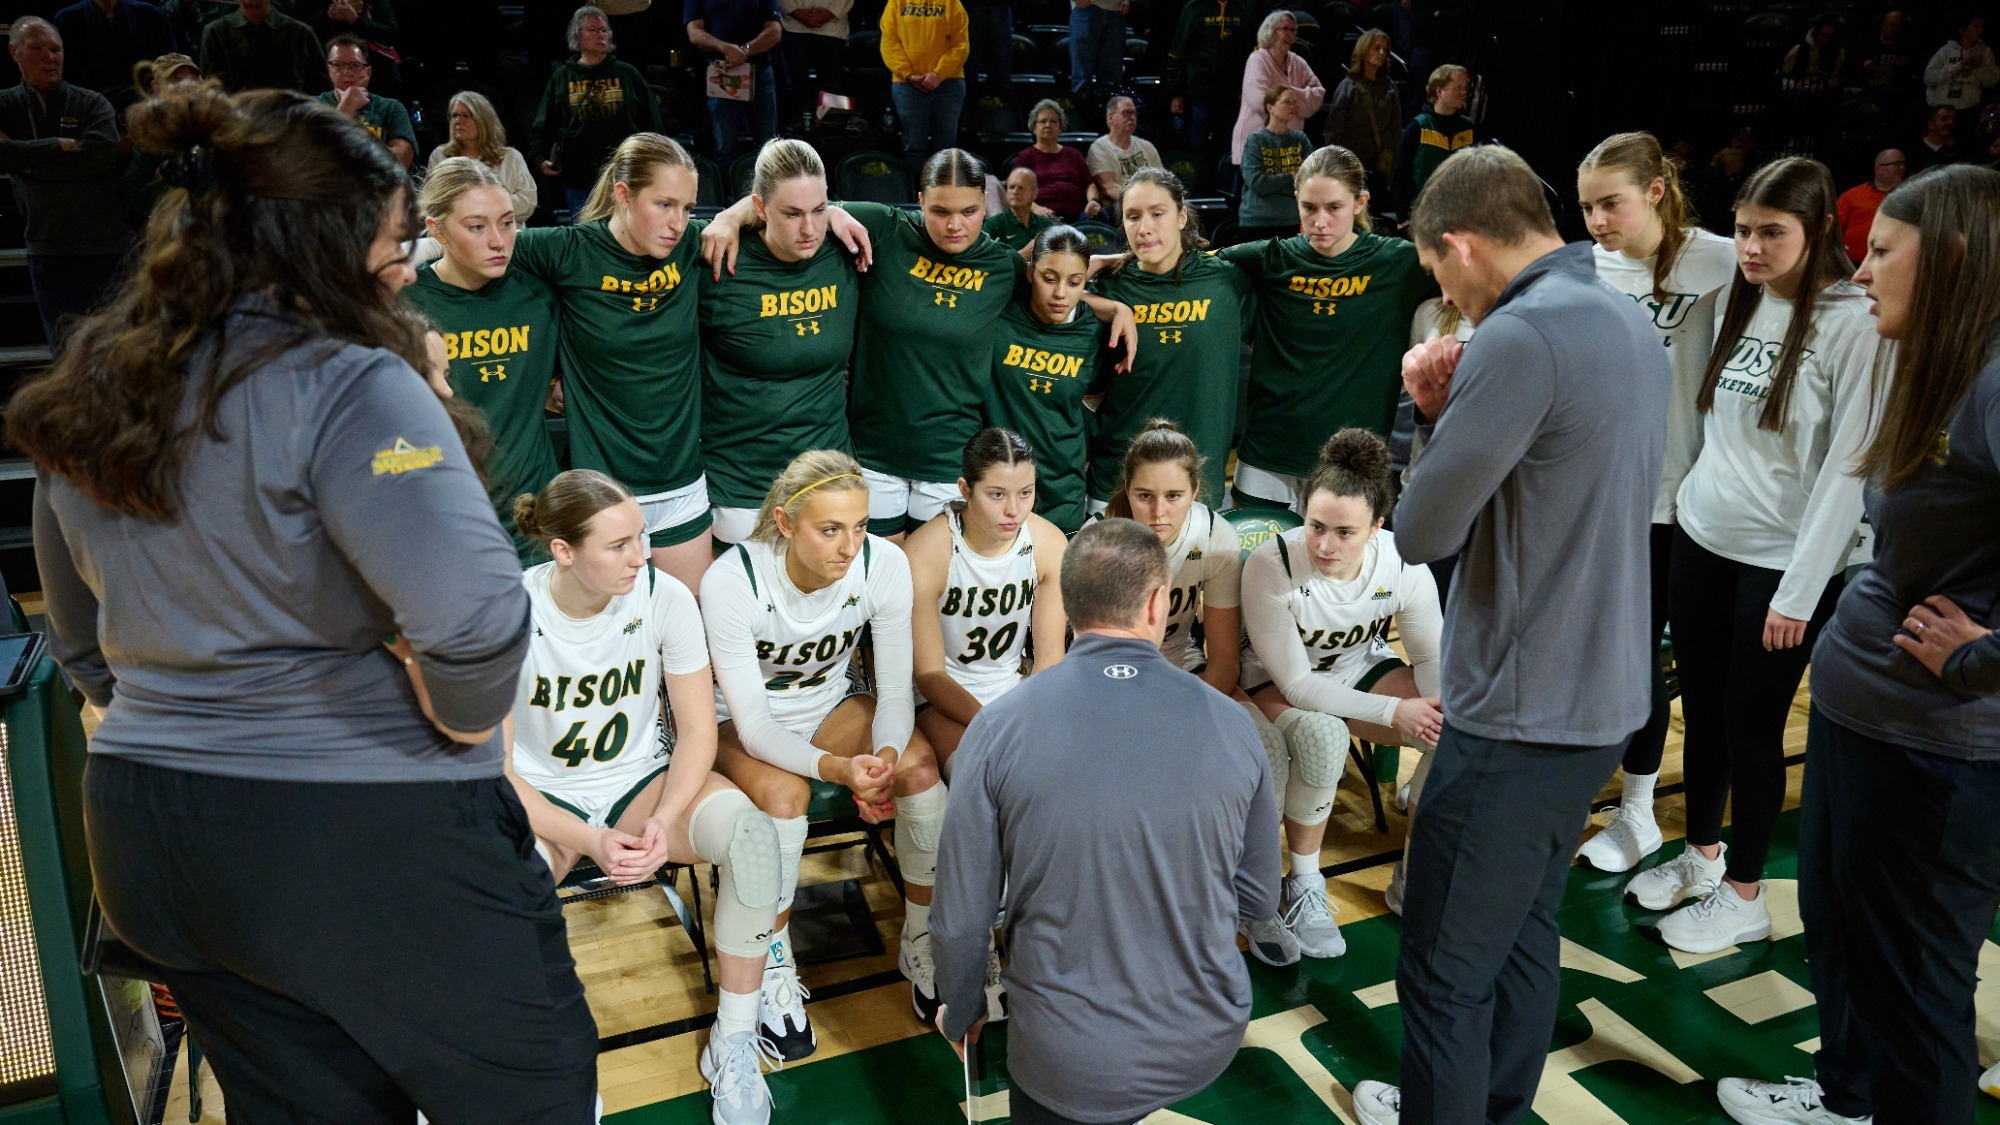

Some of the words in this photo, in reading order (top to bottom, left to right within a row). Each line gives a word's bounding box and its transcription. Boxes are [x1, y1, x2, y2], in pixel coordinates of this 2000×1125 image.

[1281, 156, 1302, 166] BISO
[601, 262, 681, 294] BISON
[909, 255, 990, 292] BISON
[1289, 275, 1371, 298] BISON
[760, 285, 837, 318] BISON
[1133, 299, 1211, 325] BISON
[442, 325, 530, 361] BISON
[1003, 344, 1085, 378] BISON
[1715, 376, 1769, 399] SKETBAL
[1237, 532, 1268, 552] DSU
[941, 578, 1034, 618] BISON
[756, 625, 862, 666] BISON
[957, 621, 1028, 664] 30
[1293, 616, 1387, 650] ISON
[530, 659, 646, 712] BISON
[550, 711, 629, 768] 40
